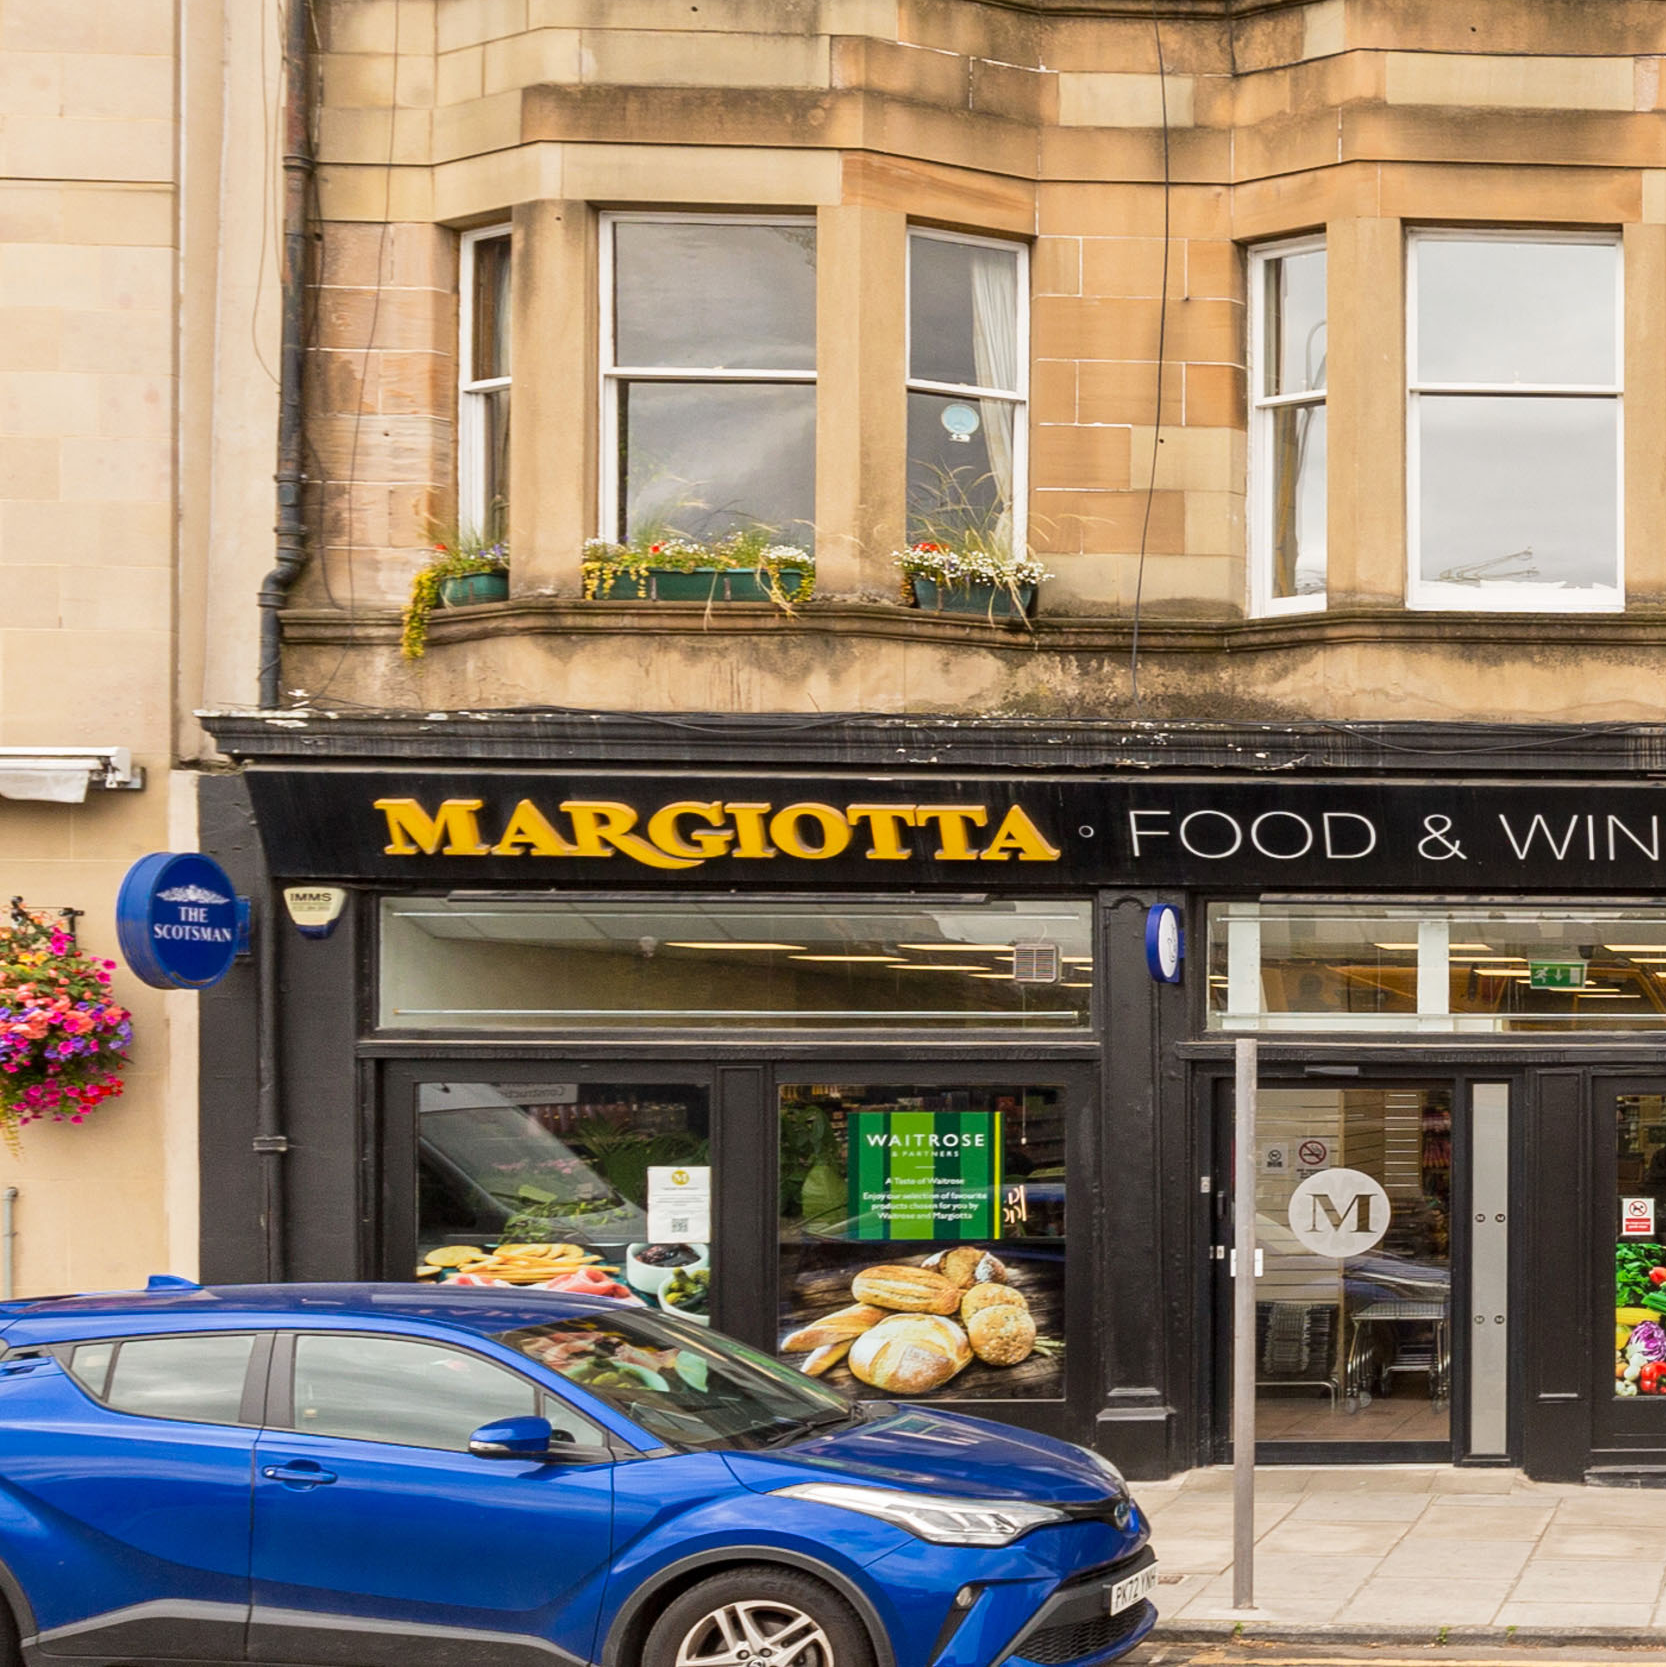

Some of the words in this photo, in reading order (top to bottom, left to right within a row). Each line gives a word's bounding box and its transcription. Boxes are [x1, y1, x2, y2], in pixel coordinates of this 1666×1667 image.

[373, 798, 1061, 870] MARGIOTTA
[1128, 810, 1377, 859] FOOD
[1417, 814, 1468, 861] &
[290, 892, 332, 902] IMMS
[177, 907, 209, 923] THE
[153, 923, 233, 943] SCOTSMAN
[866, 1134, 985, 1147] WAITROSE
[895, 1177, 915, 1185] Taste
[928, 1177, 965, 1185] Waitrose
[863, 1192, 886, 1201] Enjoy
[878, 1212, 915, 1220] Waitrose
[1304, 1193, 1379, 1234] M
